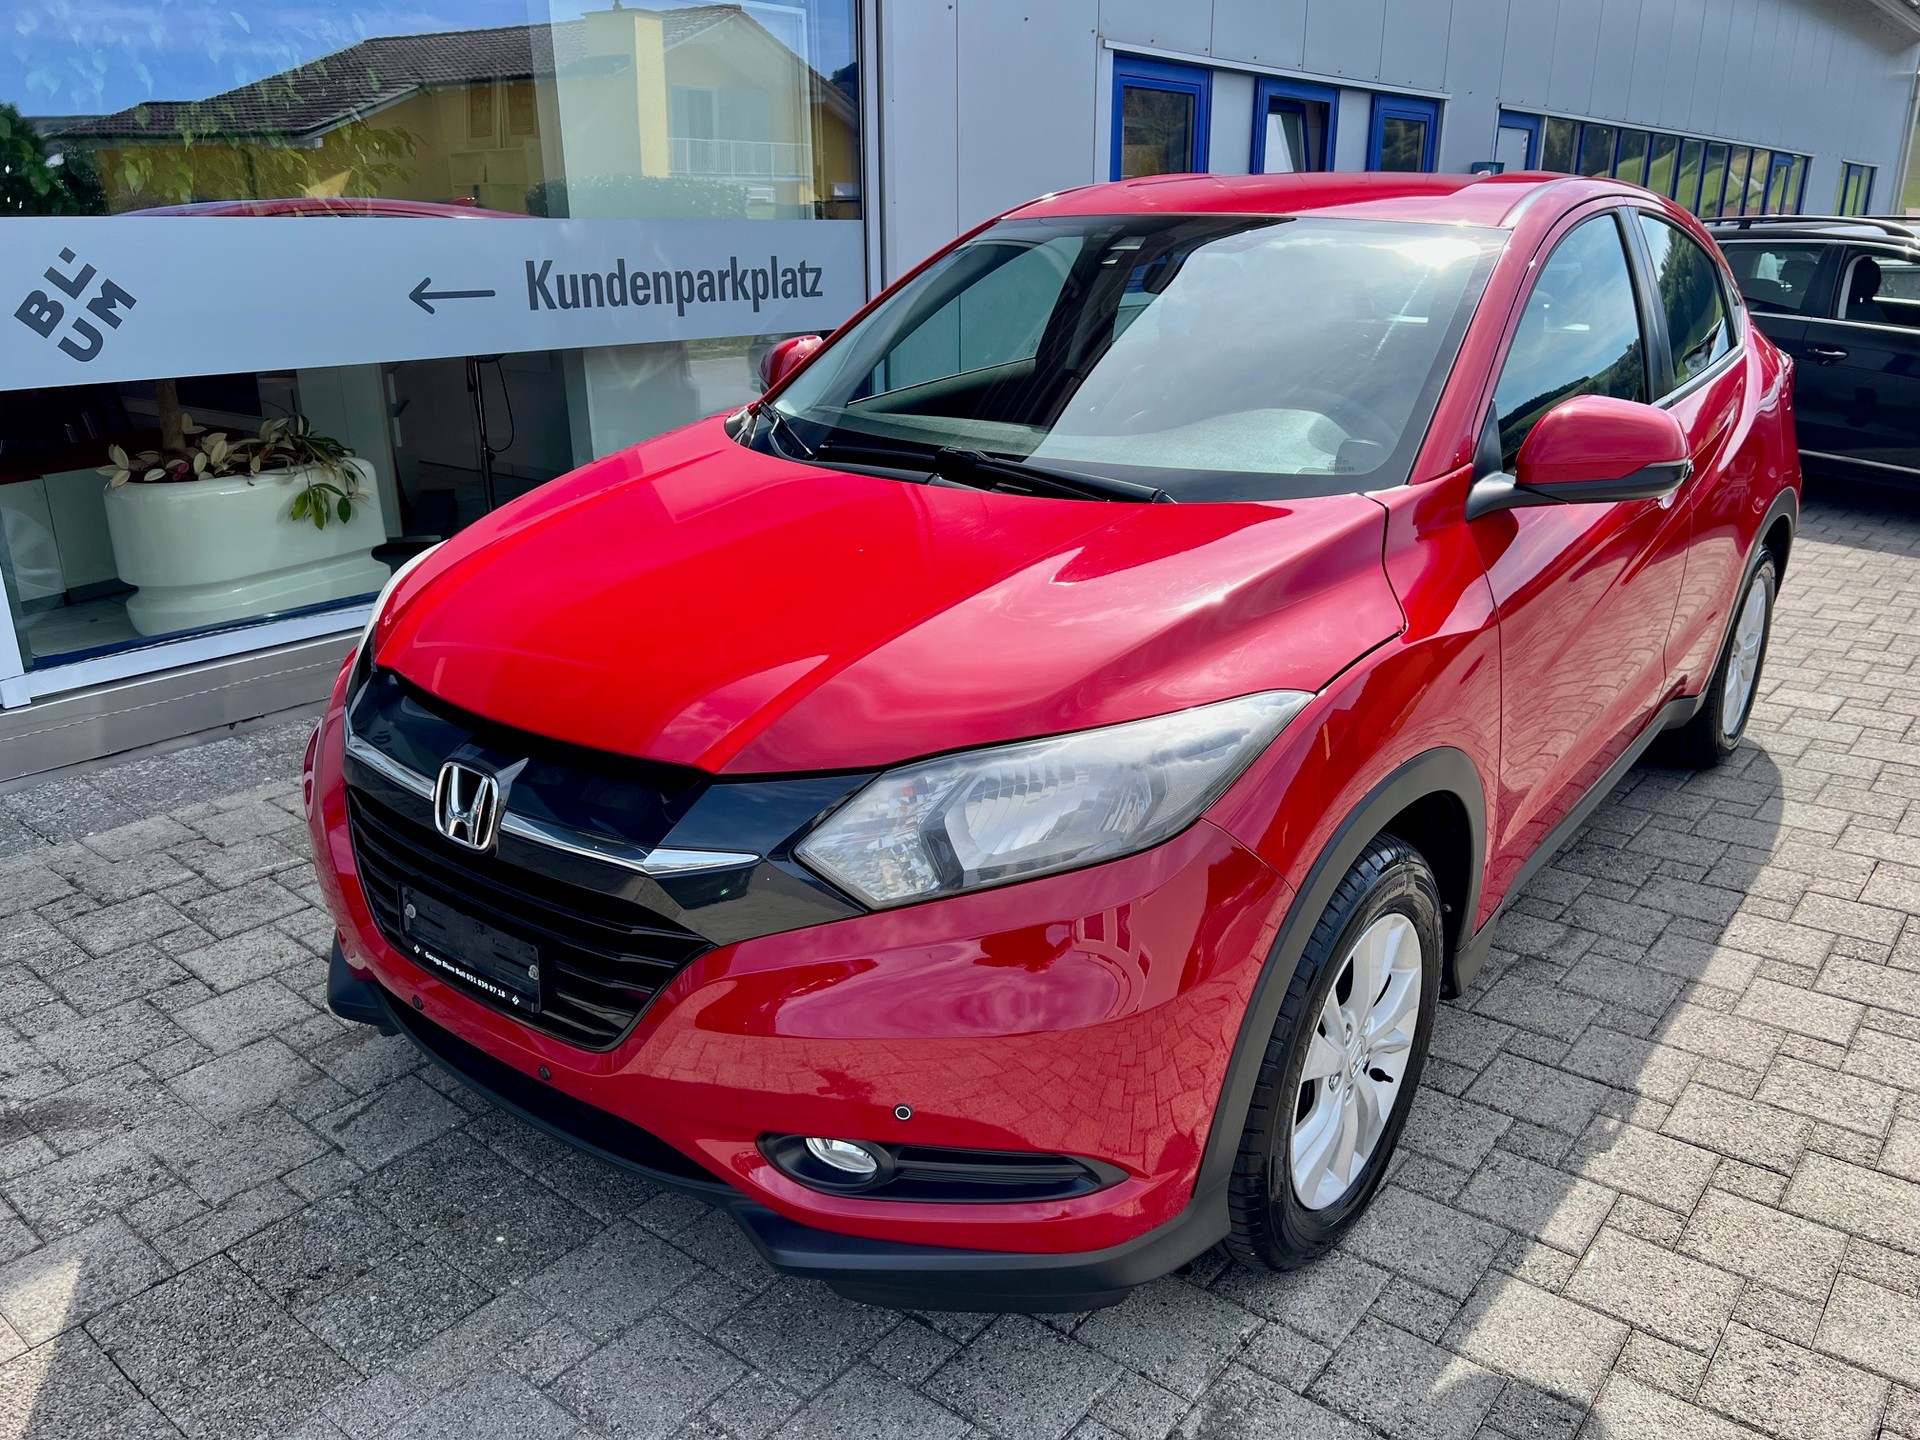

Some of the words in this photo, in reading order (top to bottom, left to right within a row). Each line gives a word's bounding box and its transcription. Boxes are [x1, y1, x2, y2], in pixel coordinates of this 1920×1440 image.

[525, 255, 824, 318] Kundenparkplatz
[424, 951, 442, 966] Garage
[442, 960, 456, 973] Blum
[466, 973, 478, 984] 031
[477, 979, 489, 990] 839
